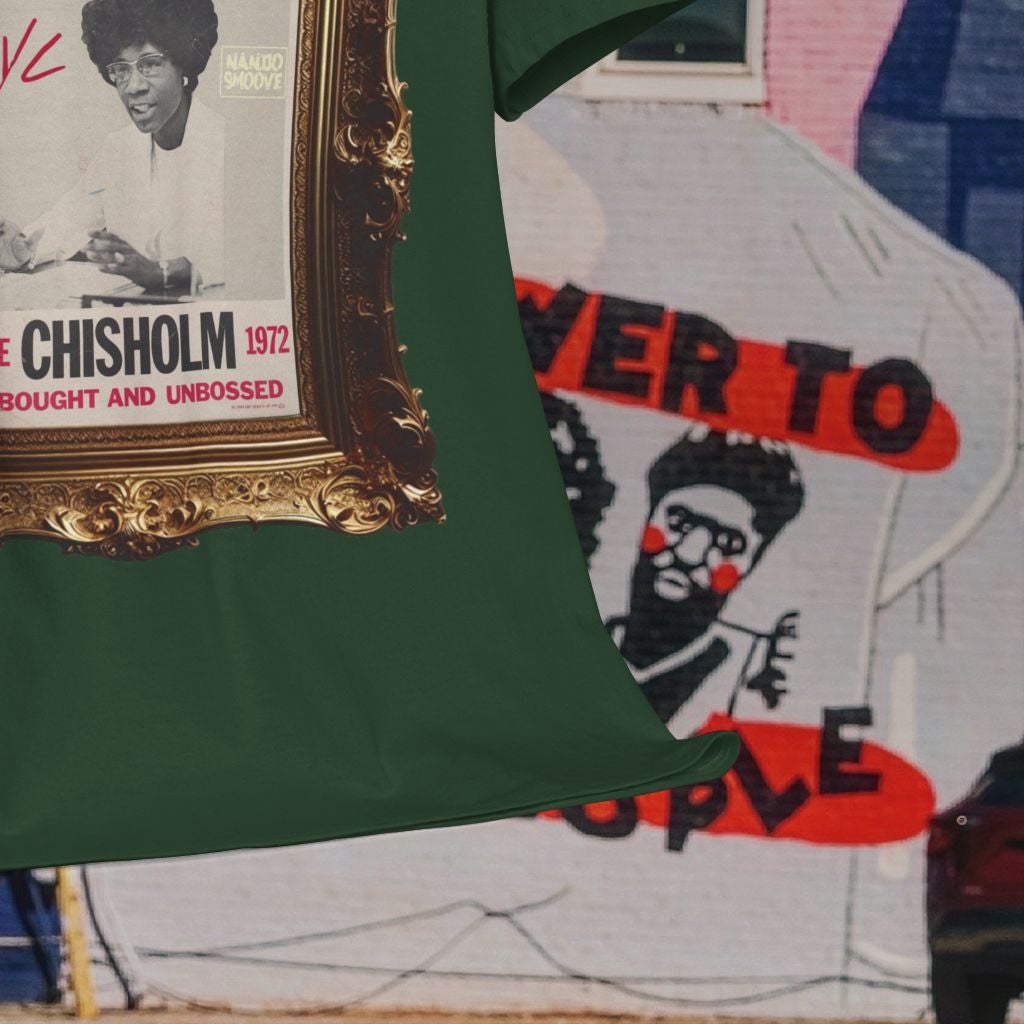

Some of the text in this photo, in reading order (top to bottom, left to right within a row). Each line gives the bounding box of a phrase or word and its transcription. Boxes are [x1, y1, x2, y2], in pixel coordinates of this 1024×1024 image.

[226, 52, 284, 71] NANDO
[223, 71, 283, 90] SMOOVE
[21, 311, 237, 380] CHISHOLM
[244, 325, 291, 356] 1972
[107, 385, 156, 408] AND
[166, 379, 284, 405] UNBOSSED
[784, 339, 934, 455] TO
